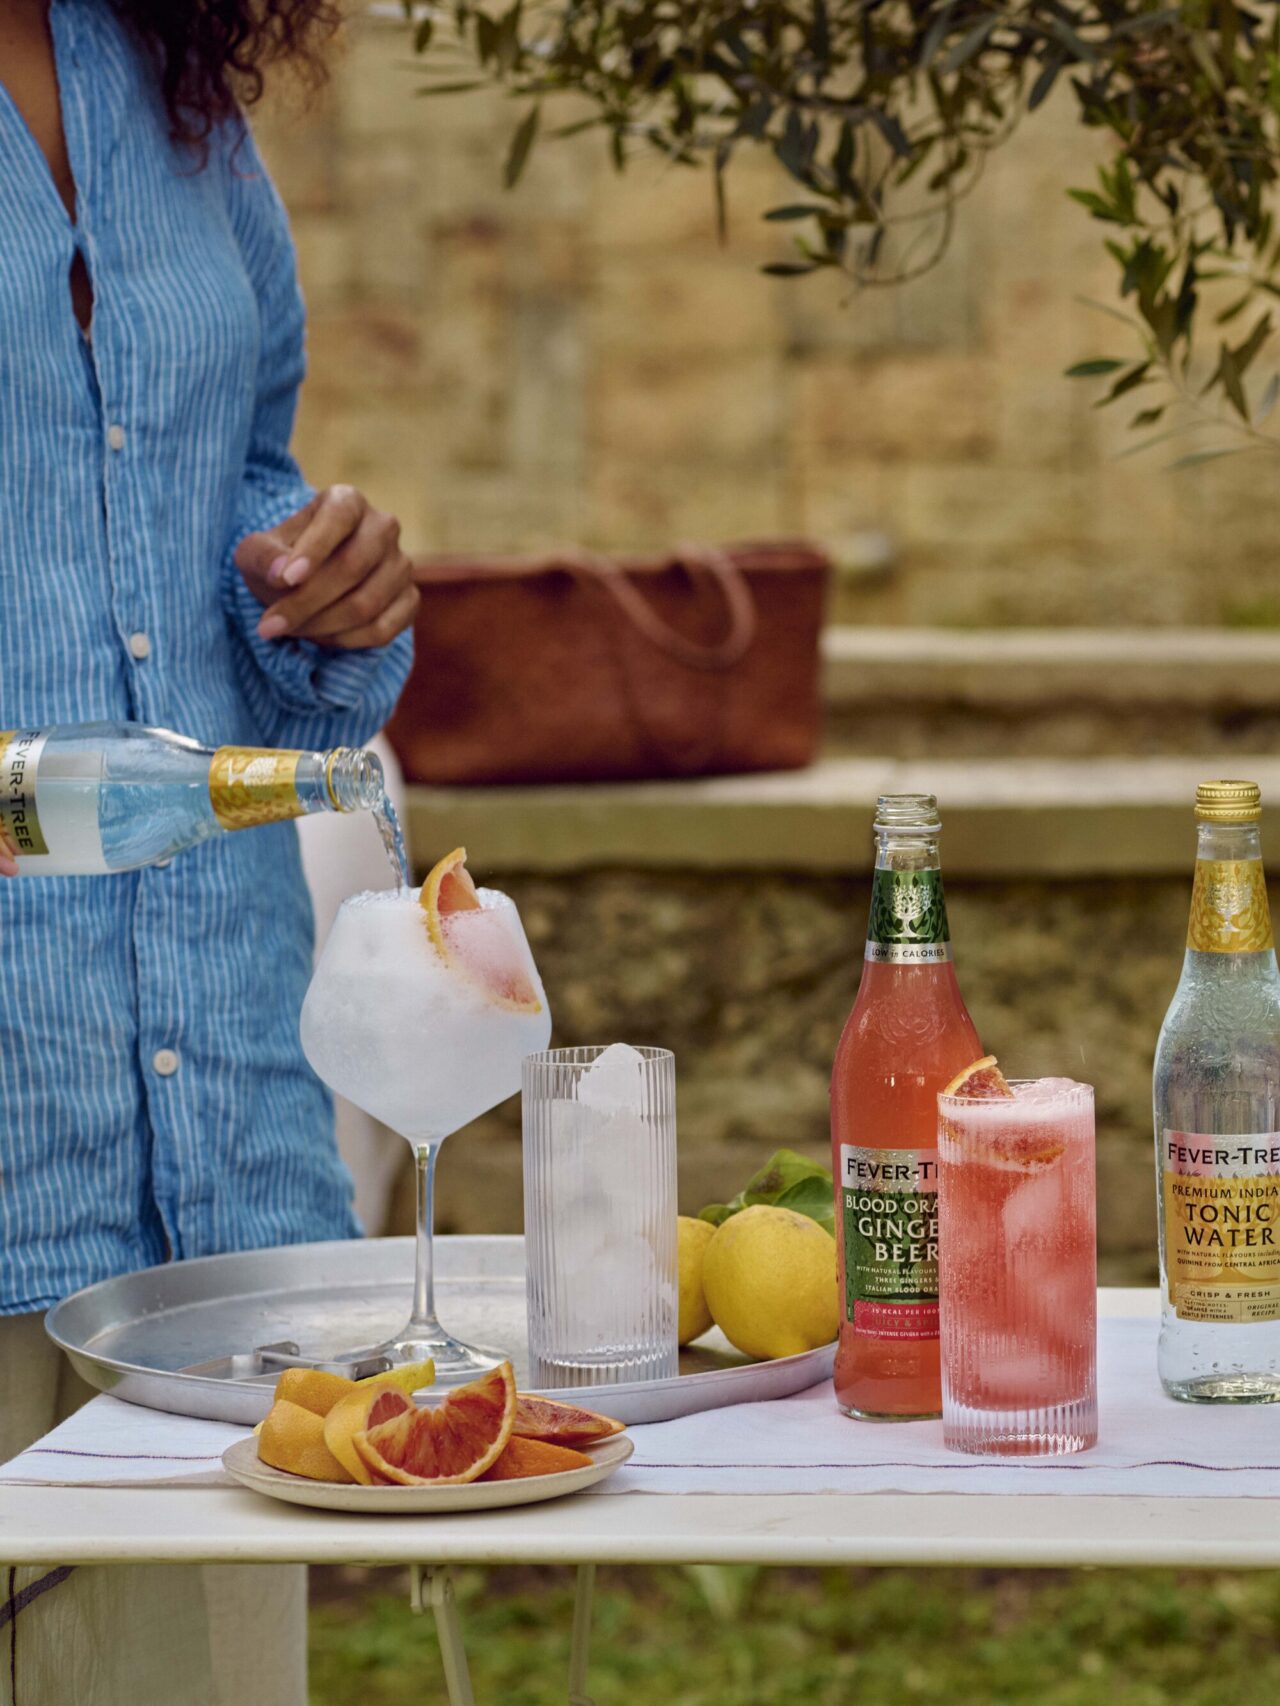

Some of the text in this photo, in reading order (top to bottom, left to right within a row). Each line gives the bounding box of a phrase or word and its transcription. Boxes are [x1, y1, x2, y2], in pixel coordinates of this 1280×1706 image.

[9, 731, 41, 849] FEVER-TREE
[872, 948, 888, 956] LOW
[902, 948, 945, 958] CALORIES
[847, 1157, 938, 1181] FEVER-T
[1172, 1184, 1232, 1199] PREMIUM
[846, 1194, 897, 1214] BLOOD
[1186, 1203, 1270, 1224] TONIC
[1184, 1226, 1275, 1247] WATER
[875, 1242, 939, 1263] BEER
[1177, 1258, 1203, 1267] QUININE
[1224, 1260, 1256, 1268] CENTRAL
[1258, 1258, 1280, 1267] AFRICA
[856, 1265, 937, 1275] WITH NATURAL FLAVOURS
[875, 1276, 897, 1284] THREE
[900, 1276, 932, 1284] GINGERS
[865, 1284, 892, 1292] ITALIAN
[1190, 1290, 1220, 1298] CRISP
[1237, 1290, 1271, 1299] FRESH
[1247, 1303, 1279, 1311] ORIGINAL
